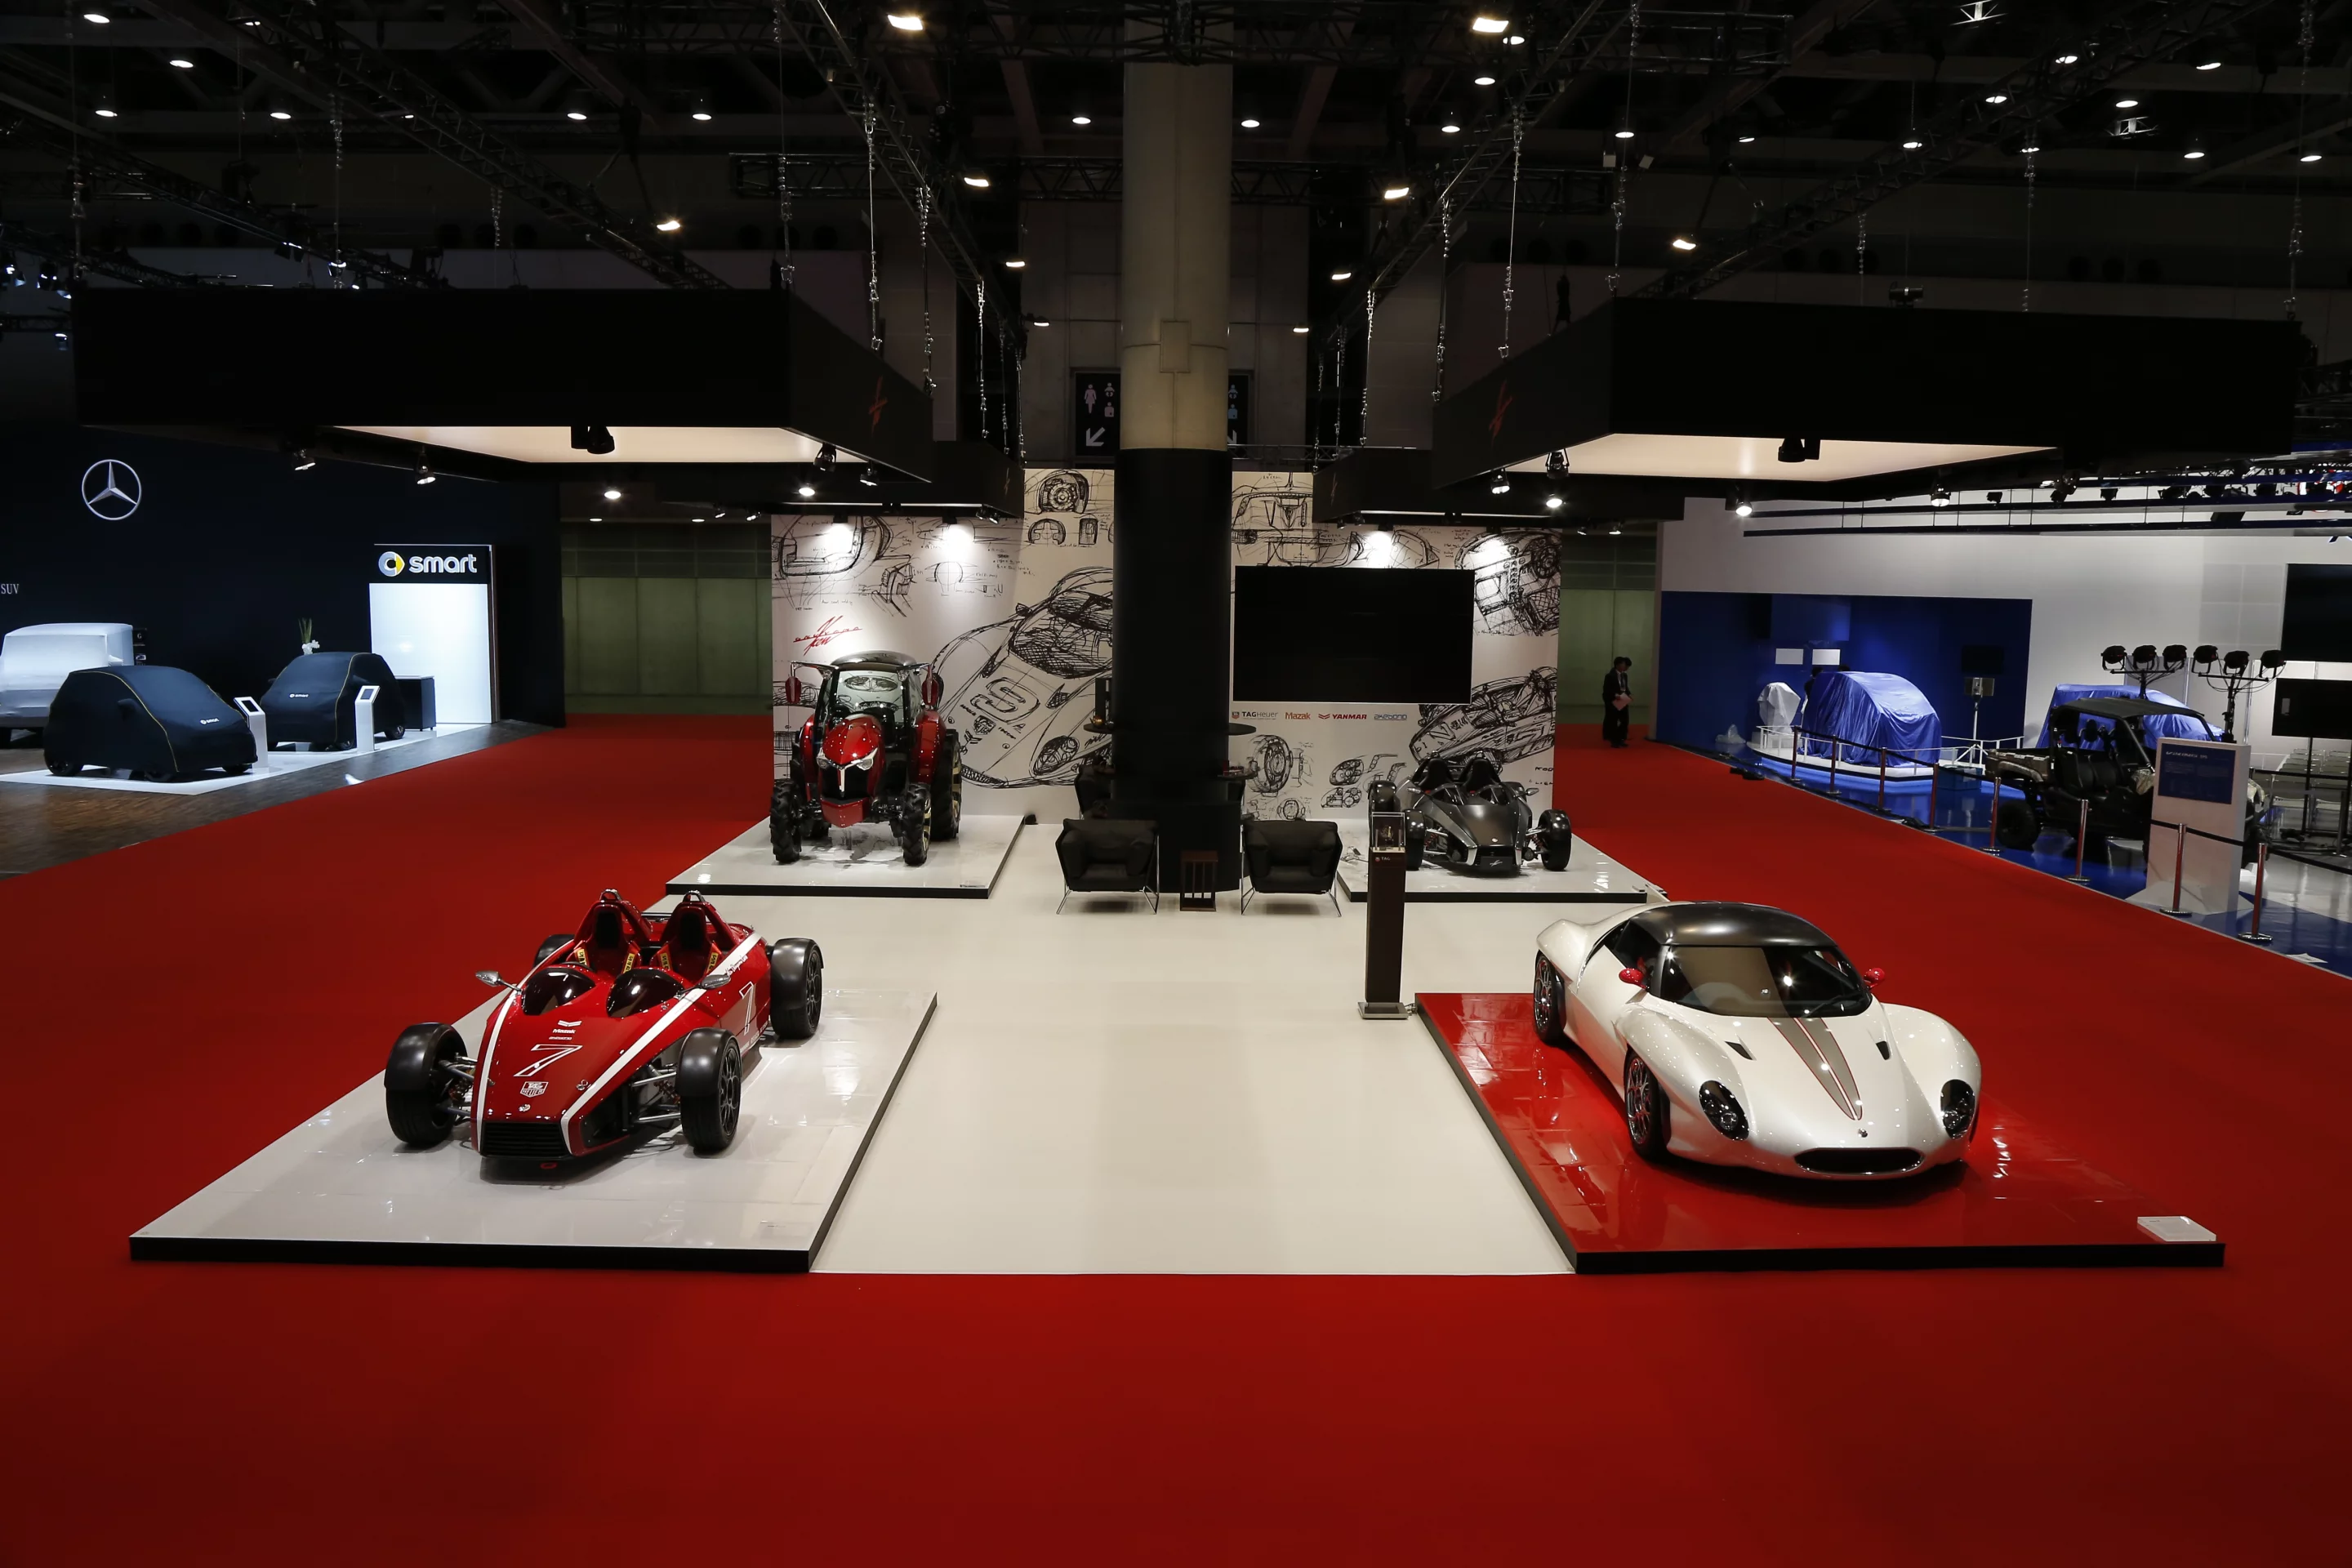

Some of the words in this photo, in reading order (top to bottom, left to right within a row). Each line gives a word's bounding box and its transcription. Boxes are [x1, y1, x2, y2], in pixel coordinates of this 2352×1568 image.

[409, 554, 478, 573] smart
[1, 583, 20, 595] SUV
[513, 1044, 583, 1076] 7
